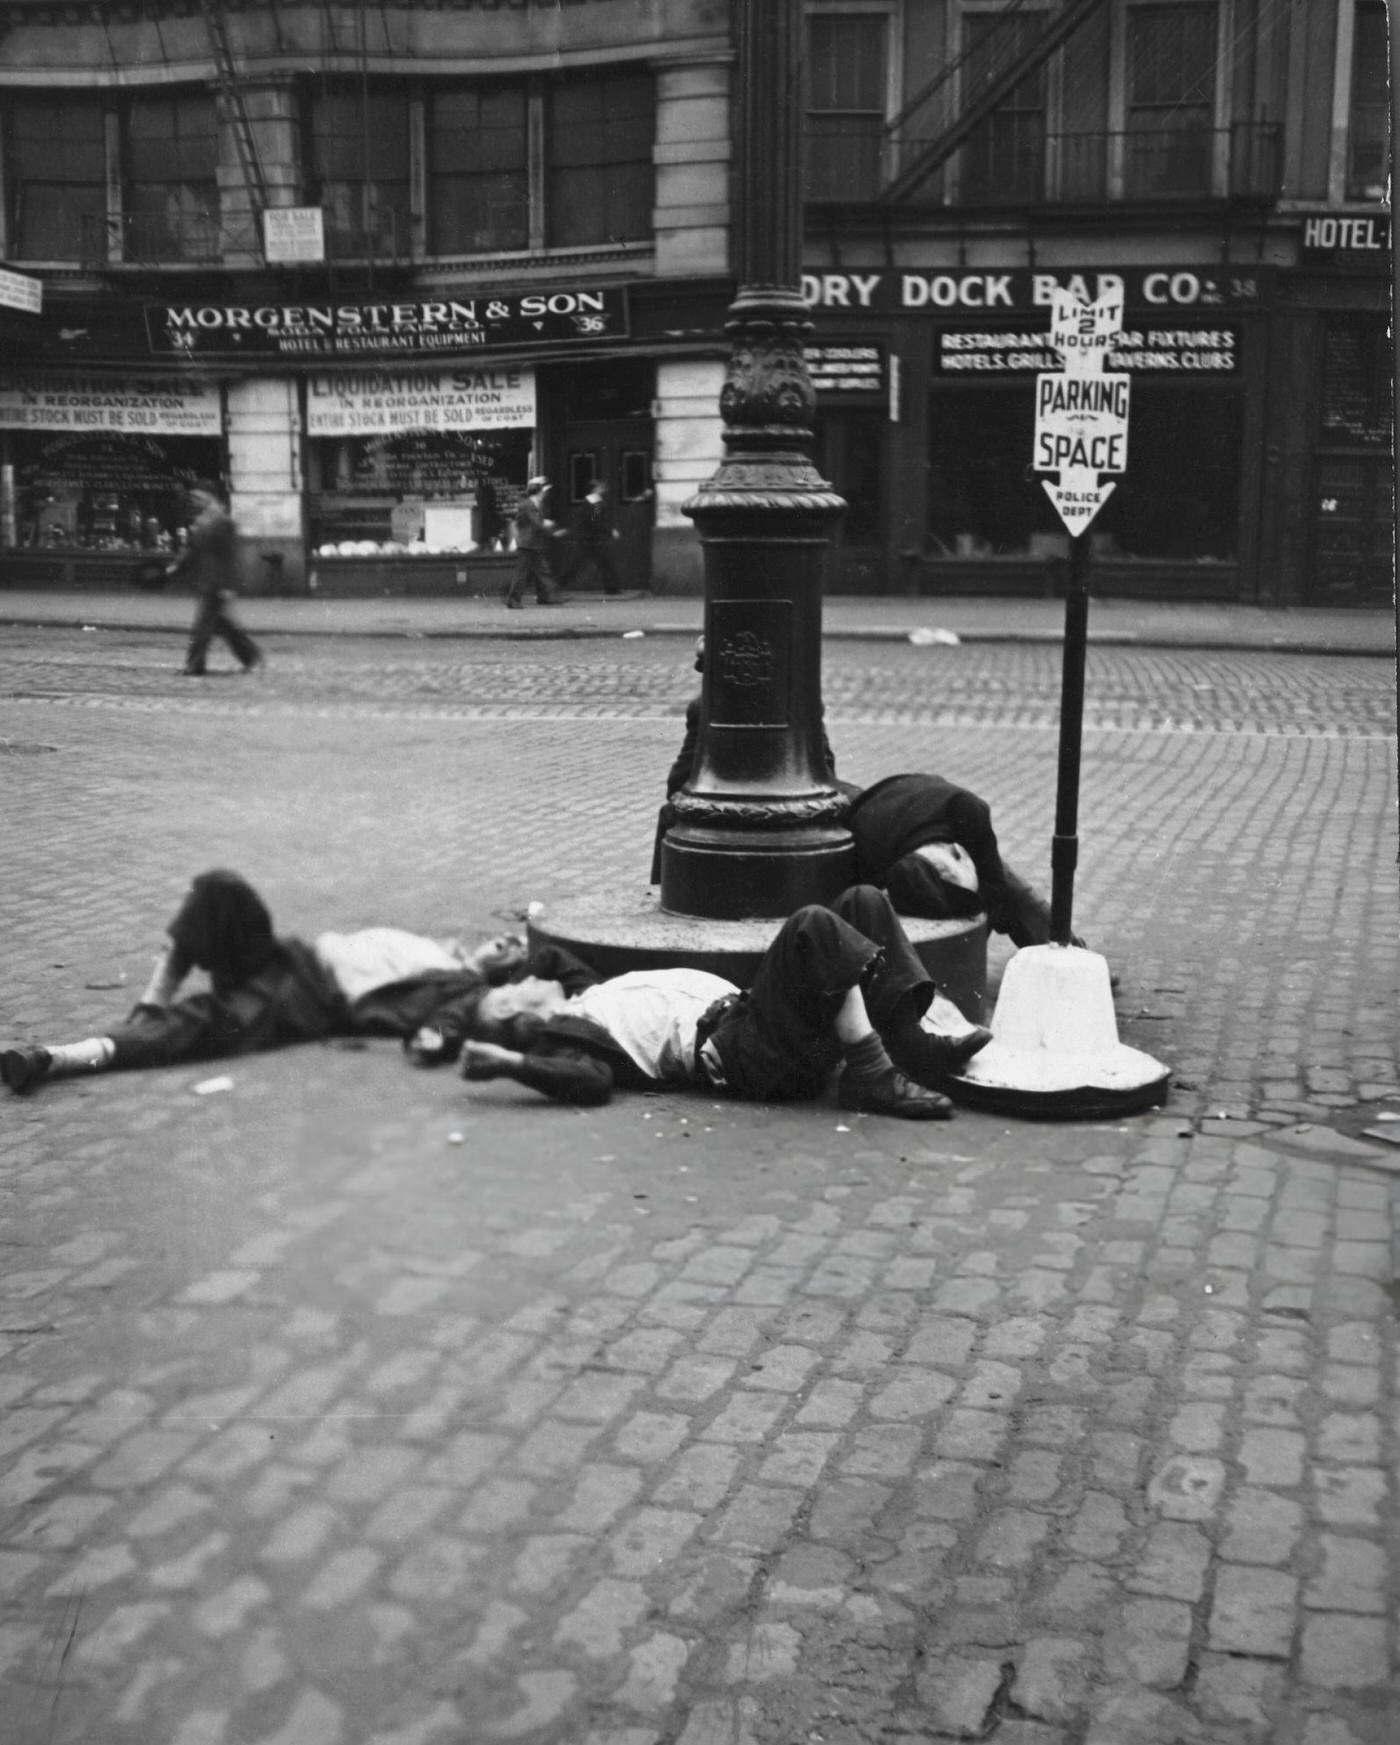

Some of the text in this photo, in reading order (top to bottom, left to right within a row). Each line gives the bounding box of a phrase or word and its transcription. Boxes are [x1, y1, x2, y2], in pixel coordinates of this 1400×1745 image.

[800, 274, 882, 306] DRY
[902, 274, 1014, 306] DOCK
[166, 291, 605, 328] MORGENSTERN & SON
[1059, 305, 1120, 322] LIMIT
[580, 315, 605, 332] 36
[1077, 318, 1096, 335] 2
[279, 338, 320, 353] HOTEL
[335, 334, 414, 350] RESTAURANT
[419, 331, 487, 347] EQUIPMENT
[1054, 331, 1120, 348] HOURS
[1148, 330, 1235, 348] FIXTURES
[312, 368, 521, 398] LIQUIDATION SALE
[44, 396, 185, 409] REORGANIZATION
[340, 392, 502, 409] IN REORGANIZATION
[1039, 379, 1128, 419] PARKING
[32, 408, 69, 424] STOCK
[74, 410, 105, 425] MUST
[109, 411, 124, 426] BE
[128, 412, 157, 427] SOLD
[351, 410, 385, 427] STOCK
[390, 409, 419, 426] MUST
[424, 408, 439, 424] BE
[443, 407, 473, 423] SOLD
[1039, 432, 1124, 470] SPACE
[1056, 491, 1101, 503] POLICE
[1062, 506, 1094, 517] DEPT
